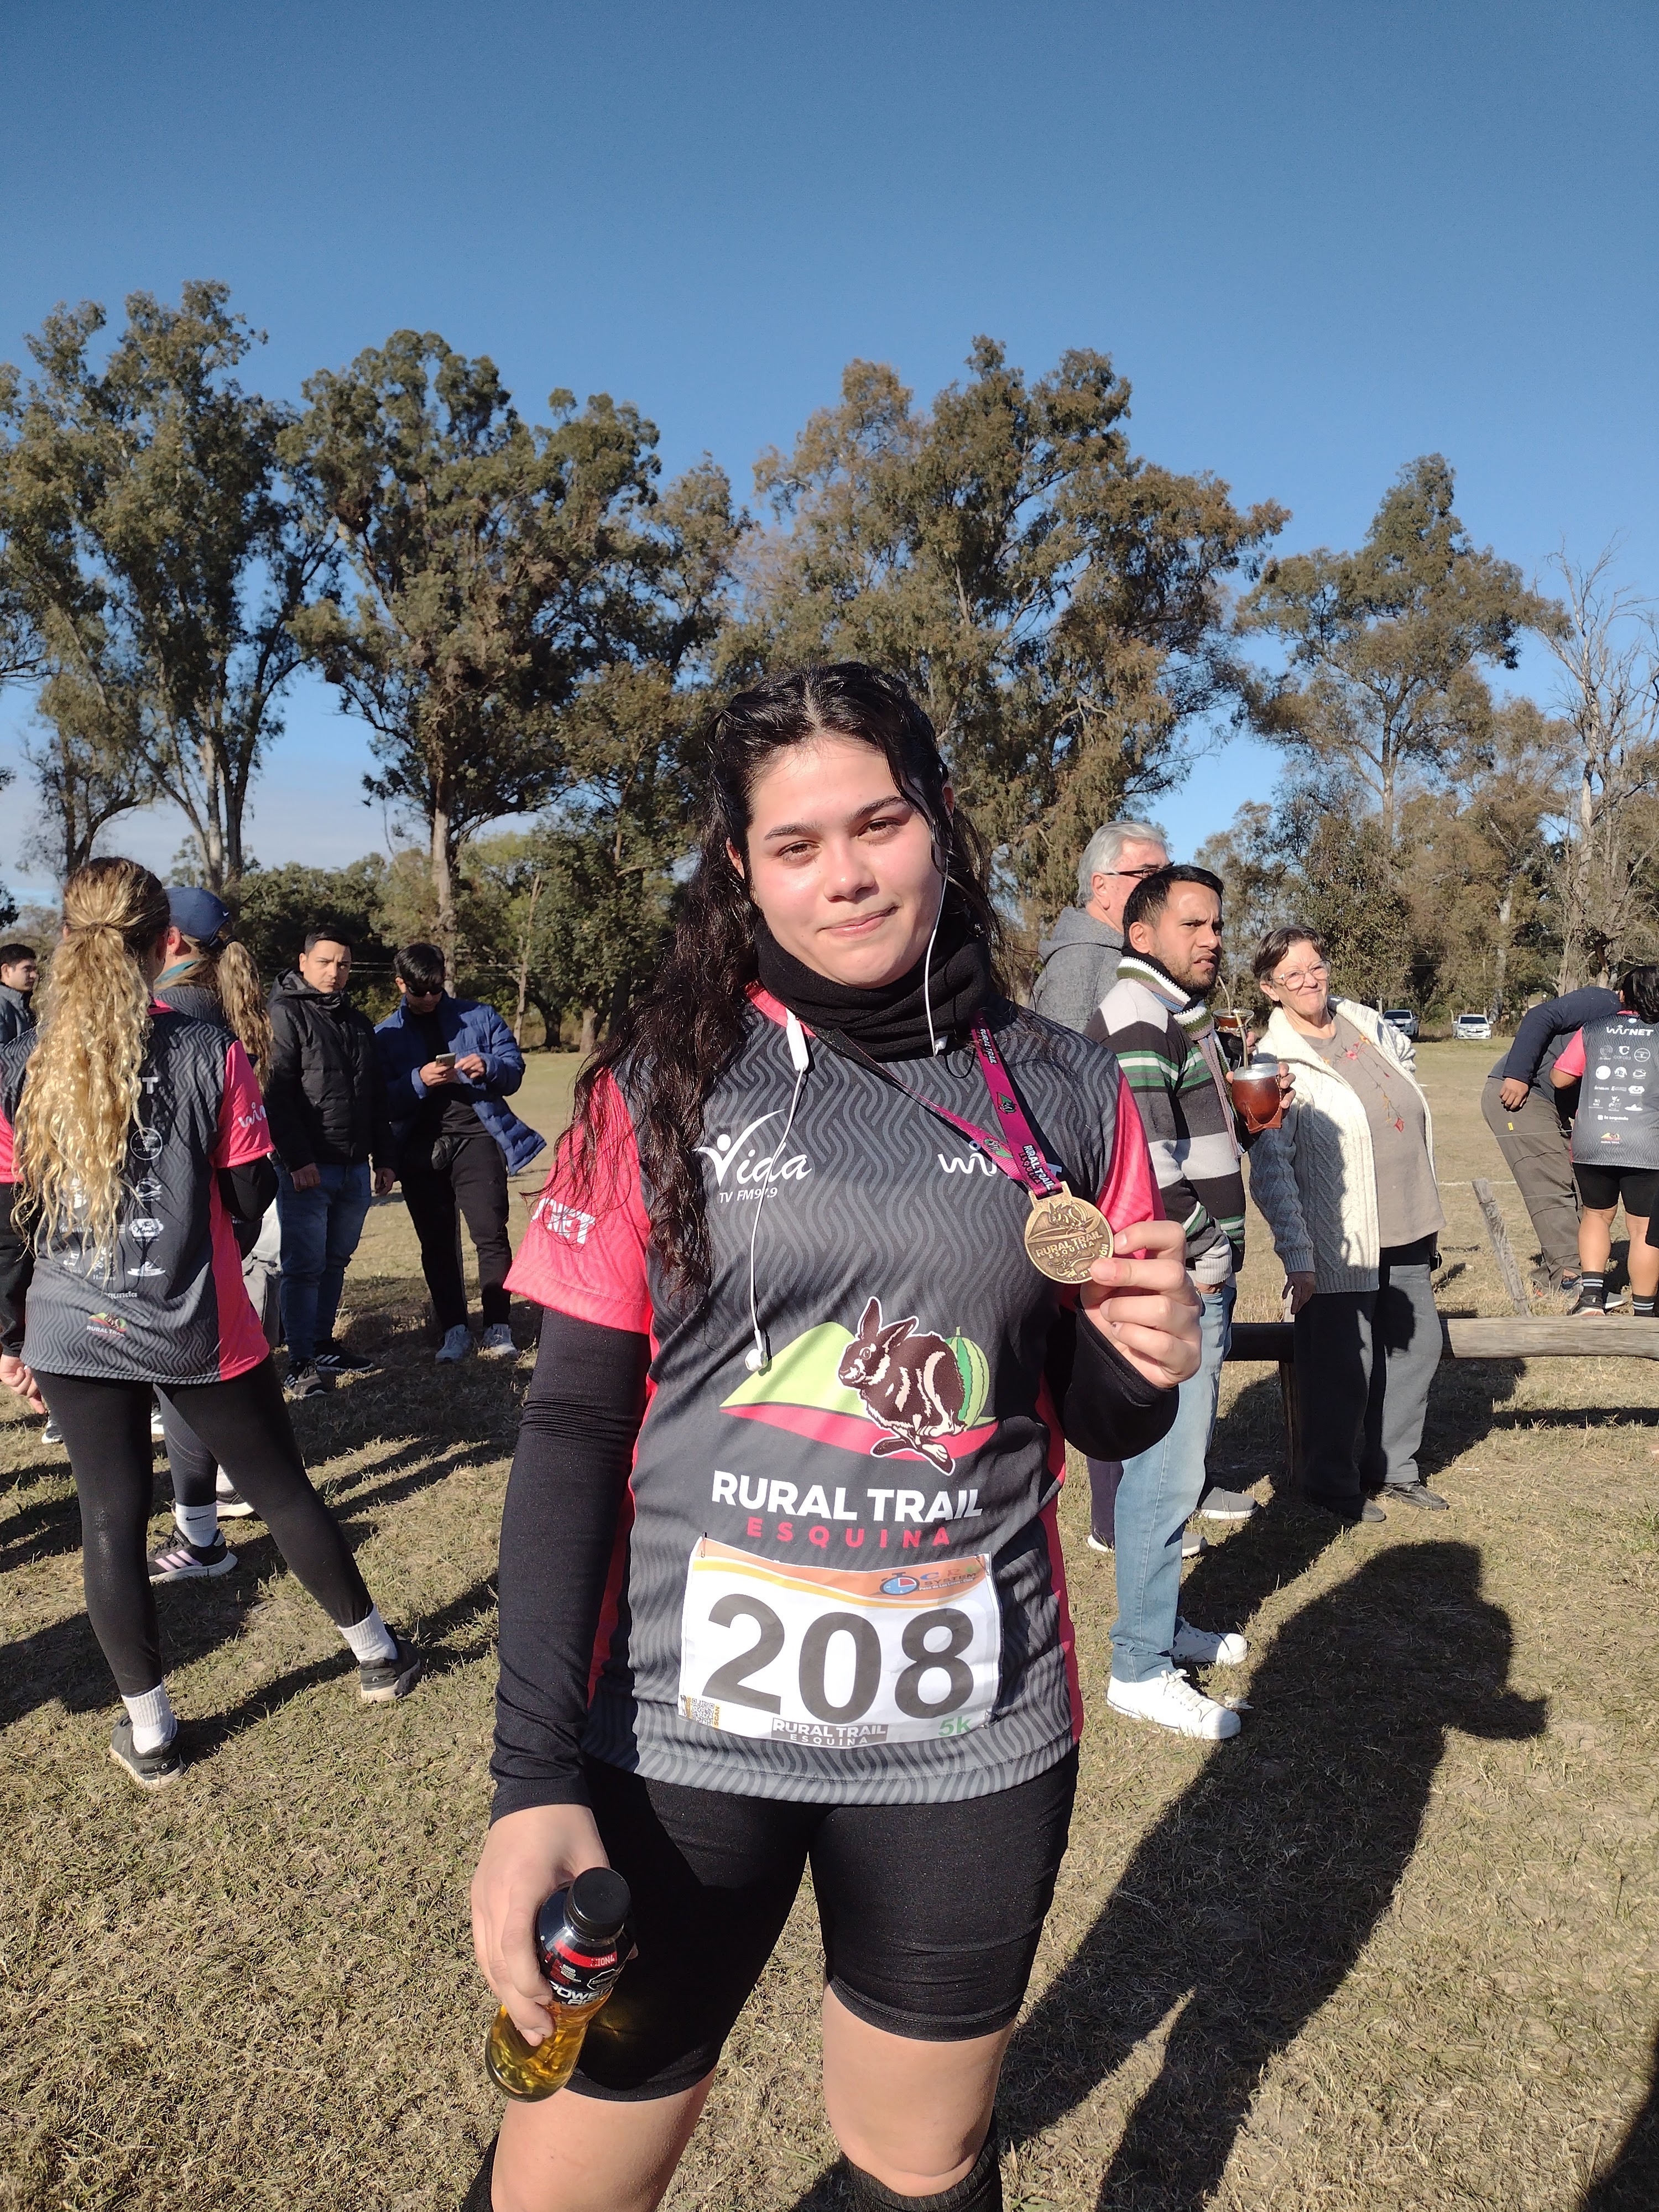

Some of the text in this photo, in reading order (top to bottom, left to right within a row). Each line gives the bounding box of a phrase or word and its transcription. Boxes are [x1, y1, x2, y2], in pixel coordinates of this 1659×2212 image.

[1024, 1145, 1054, 1190] RURAL TRAIL
[719, 1192, 733, 1203] TV
[1036, 1230, 1103, 1258] RURAL TRAIL
[1049, 1241, 1095, 1259] ESQUINA
[86, 1326, 108, 1334] RURAL
[711, 1470, 983, 1522] RURAL TRAIL
[747, 1517, 950, 1548] ESQUINA
[924, 1573, 976, 1585] SYSTEM
[701, 1593, 974, 1725] 208
[773, 1720, 886, 1738] RURAL TRAIL
[790, 1734, 868, 1746] ESQUINA
